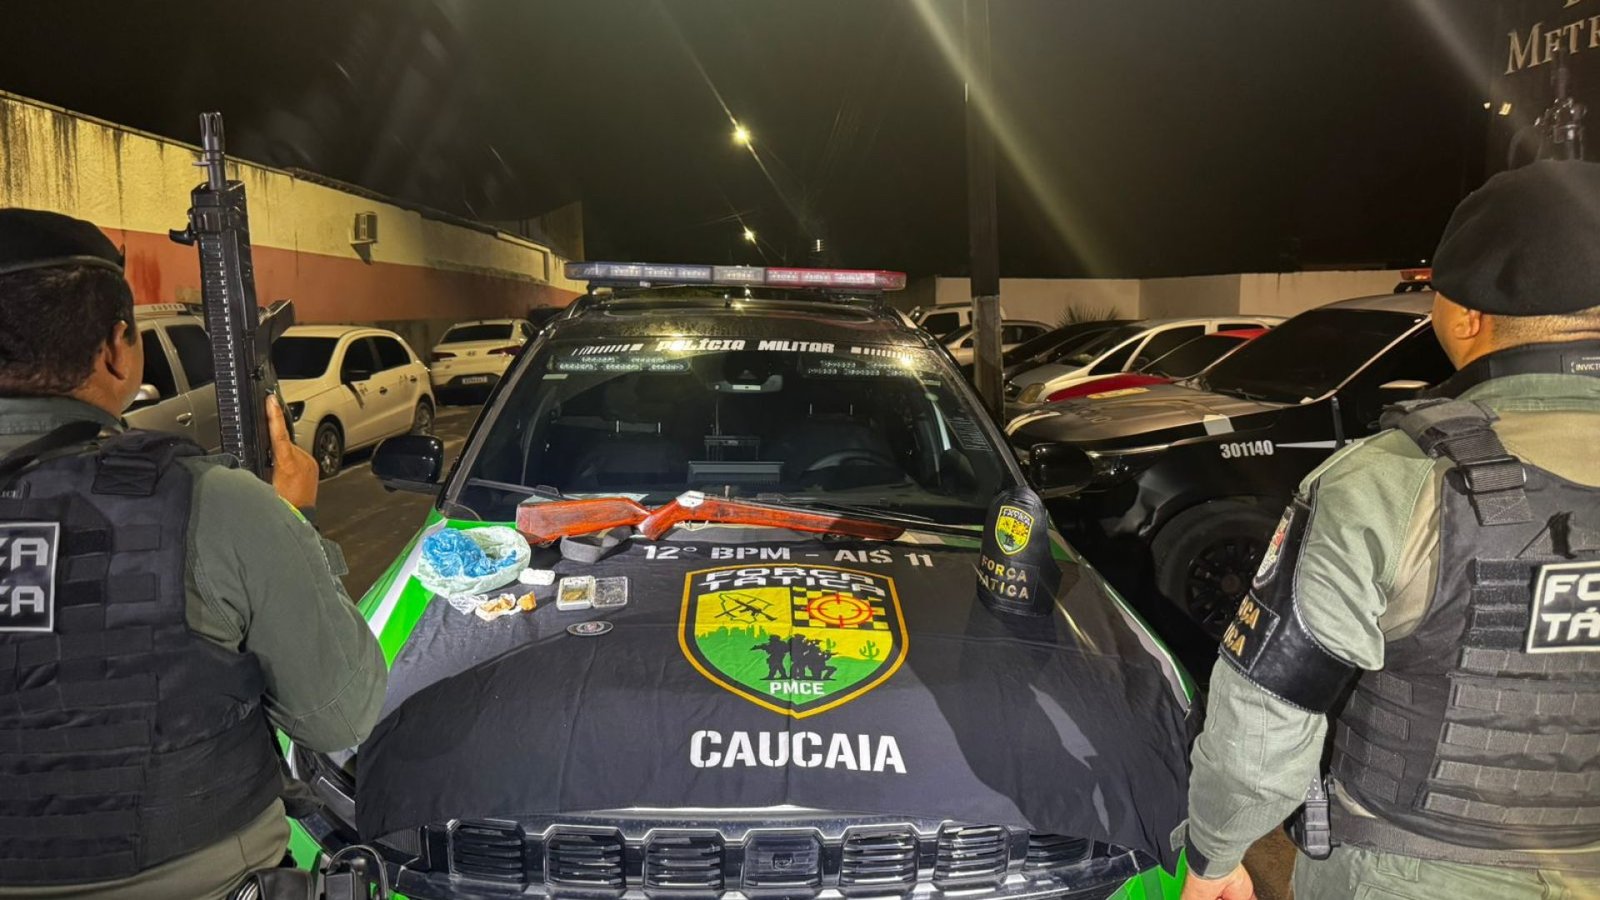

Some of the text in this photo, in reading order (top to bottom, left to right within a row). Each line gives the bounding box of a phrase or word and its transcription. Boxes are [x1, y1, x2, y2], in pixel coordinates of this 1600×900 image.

[757, 340, 835, 353] MILITAR
[1219, 440, 1274, 459] 301140
[710, 546, 791, 560] BPM
[834, 549, 893, 564] AIS
[904, 552, 934, 567] 11
[769, 681, 825, 695] PMCE
[690, 730, 907, 774] CAUCAIA
